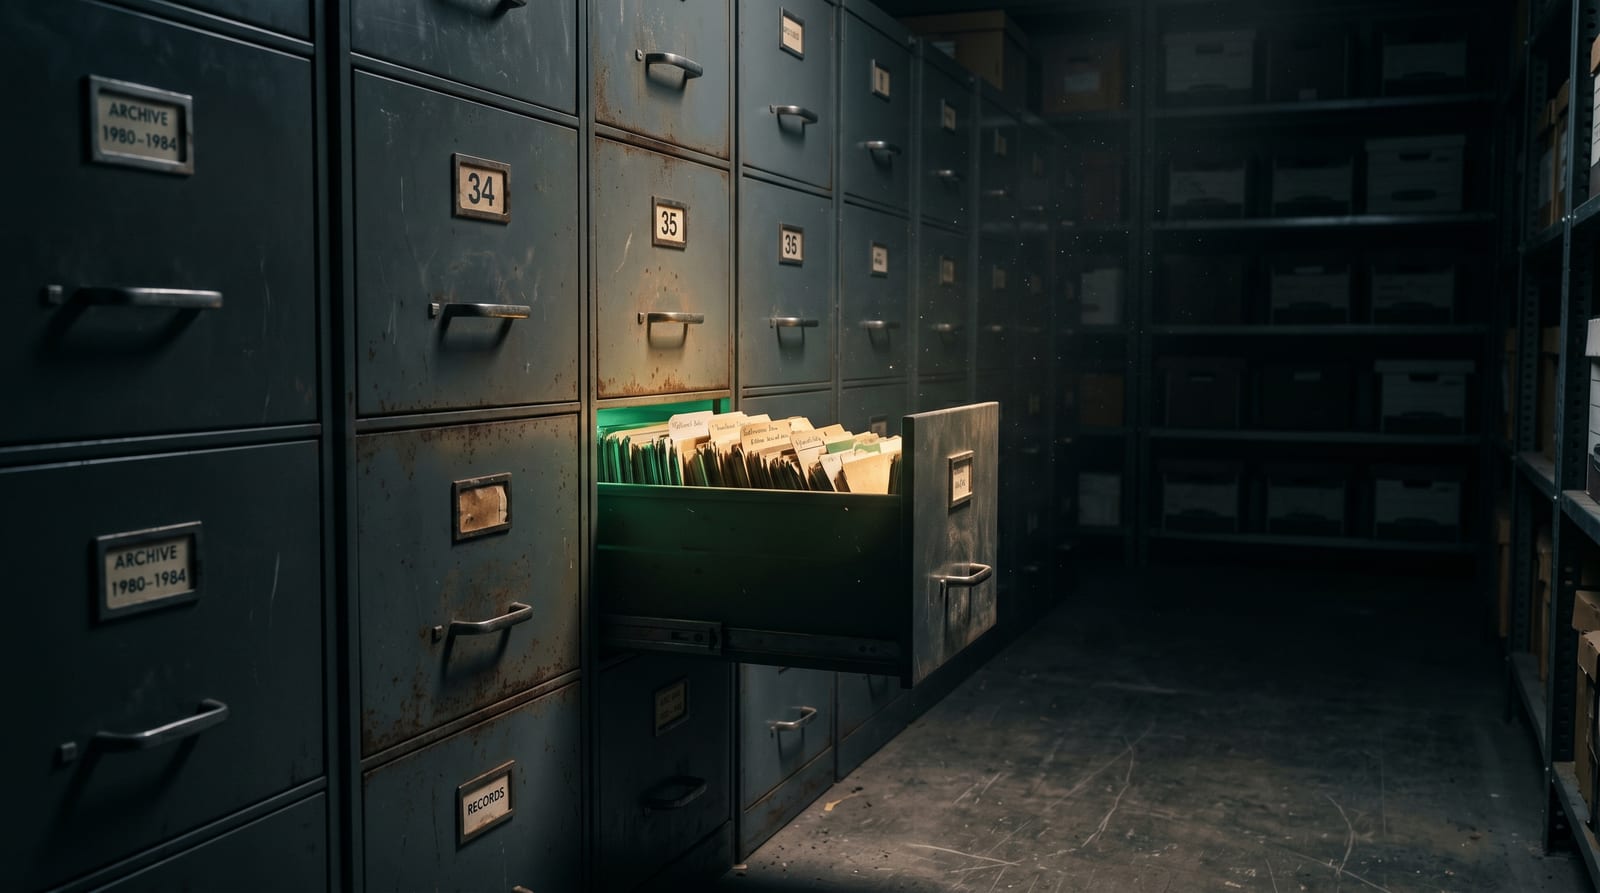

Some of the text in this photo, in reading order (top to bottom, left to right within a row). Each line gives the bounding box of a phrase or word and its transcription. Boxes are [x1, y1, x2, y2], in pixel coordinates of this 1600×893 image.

[108, 102, 168, 126] ARCHIVE
[468, 172, 495, 207] 34
[661, 211, 678, 236] 35
[785, 234, 797, 255] 35
[114, 545, 177, 570] ARCHIVE
[467, 787, 505, 816] RECORDS
